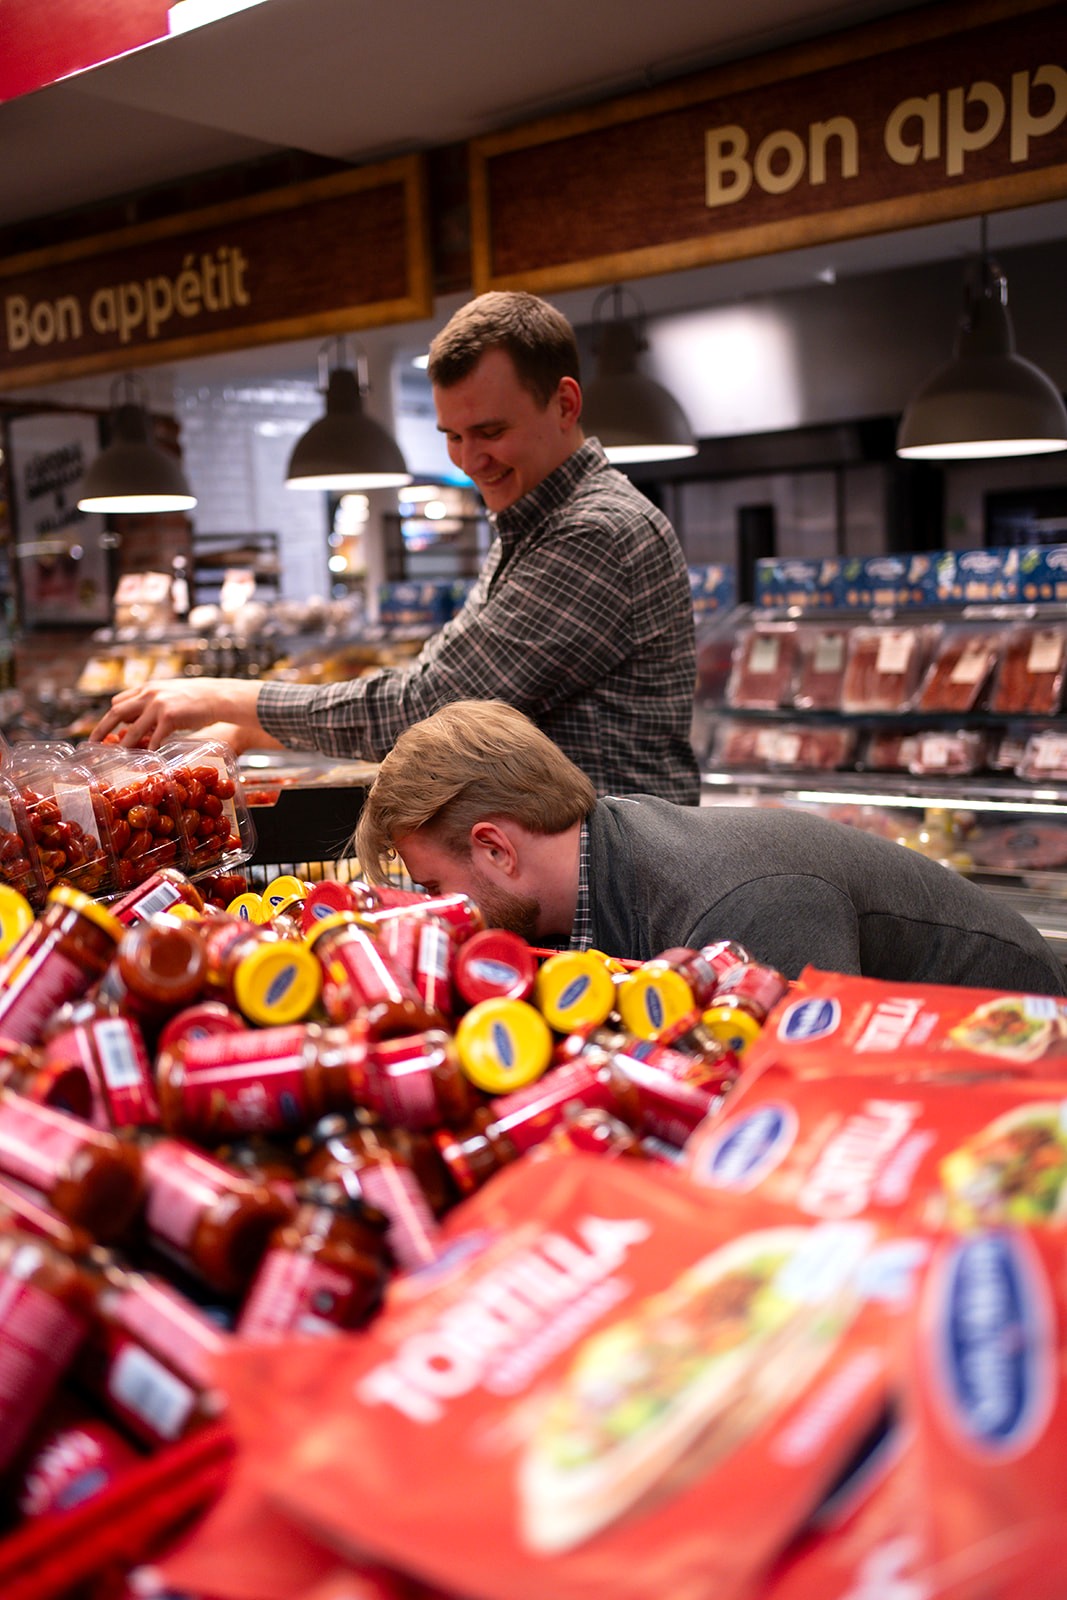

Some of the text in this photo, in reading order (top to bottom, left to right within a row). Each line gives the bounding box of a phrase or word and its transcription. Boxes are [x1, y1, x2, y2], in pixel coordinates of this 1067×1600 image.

[705, 64, 1067, 208] Bon app
[5, 247, 250, 351] Bon appétit
[357, 1215, 652, 1422] TORTILLA
